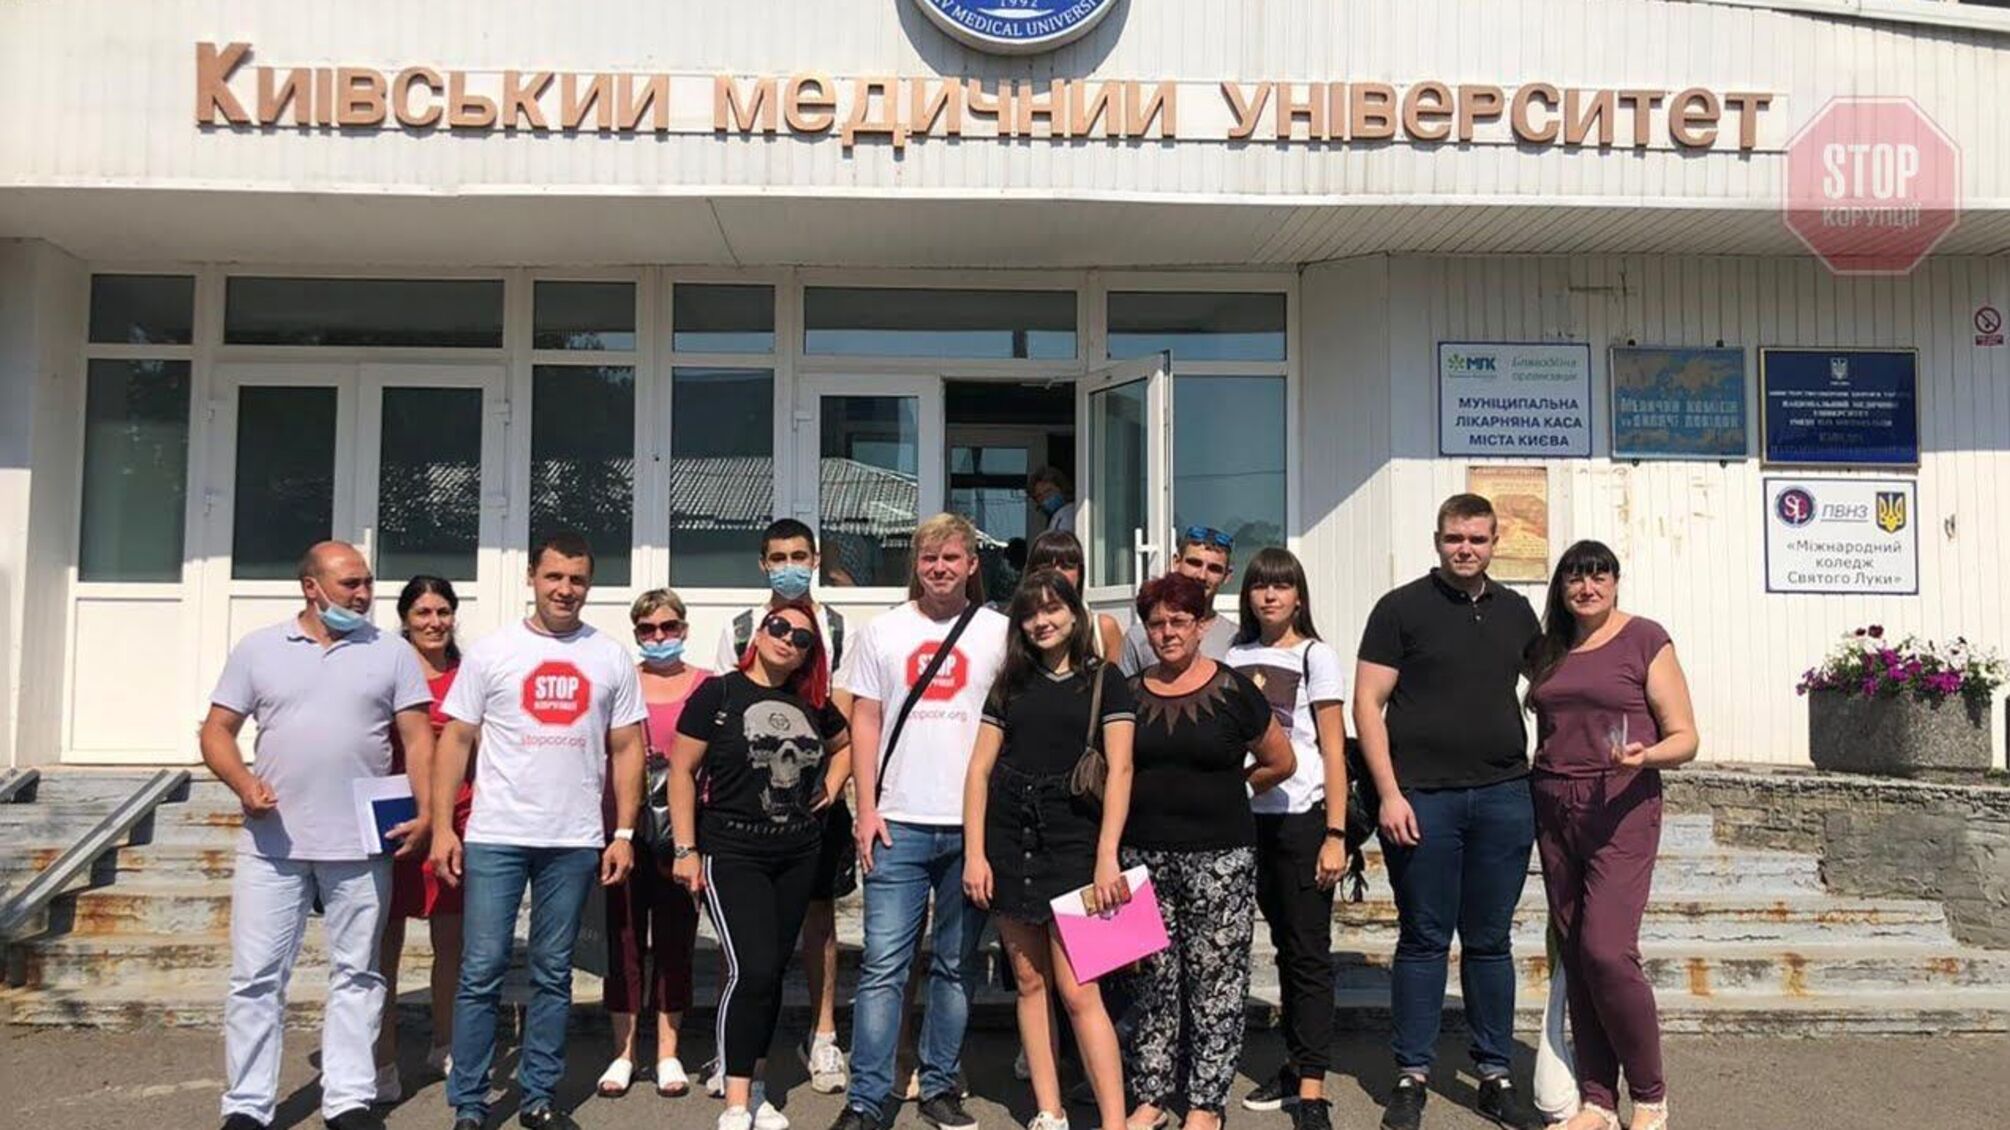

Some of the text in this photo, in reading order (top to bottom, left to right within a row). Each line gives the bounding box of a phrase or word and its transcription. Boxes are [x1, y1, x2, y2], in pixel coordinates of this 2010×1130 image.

[951, 5, 1022, 36] MEDICAL
[1458, 398, 1579, 411] МУНІЦИПАЛЬНА
[1456, 416, 1582, 428] ЛІКАРНЯНА КАСА
[1469, 435, 1569, 447] МІСТА КИЄВА
[1822, 503, 1868, 518] ПВНЗ
[1816, 557, 1874, 570] коледж
[1787, 571, 1851, 585] Святого
[535, 675, 579, 699] STOP
